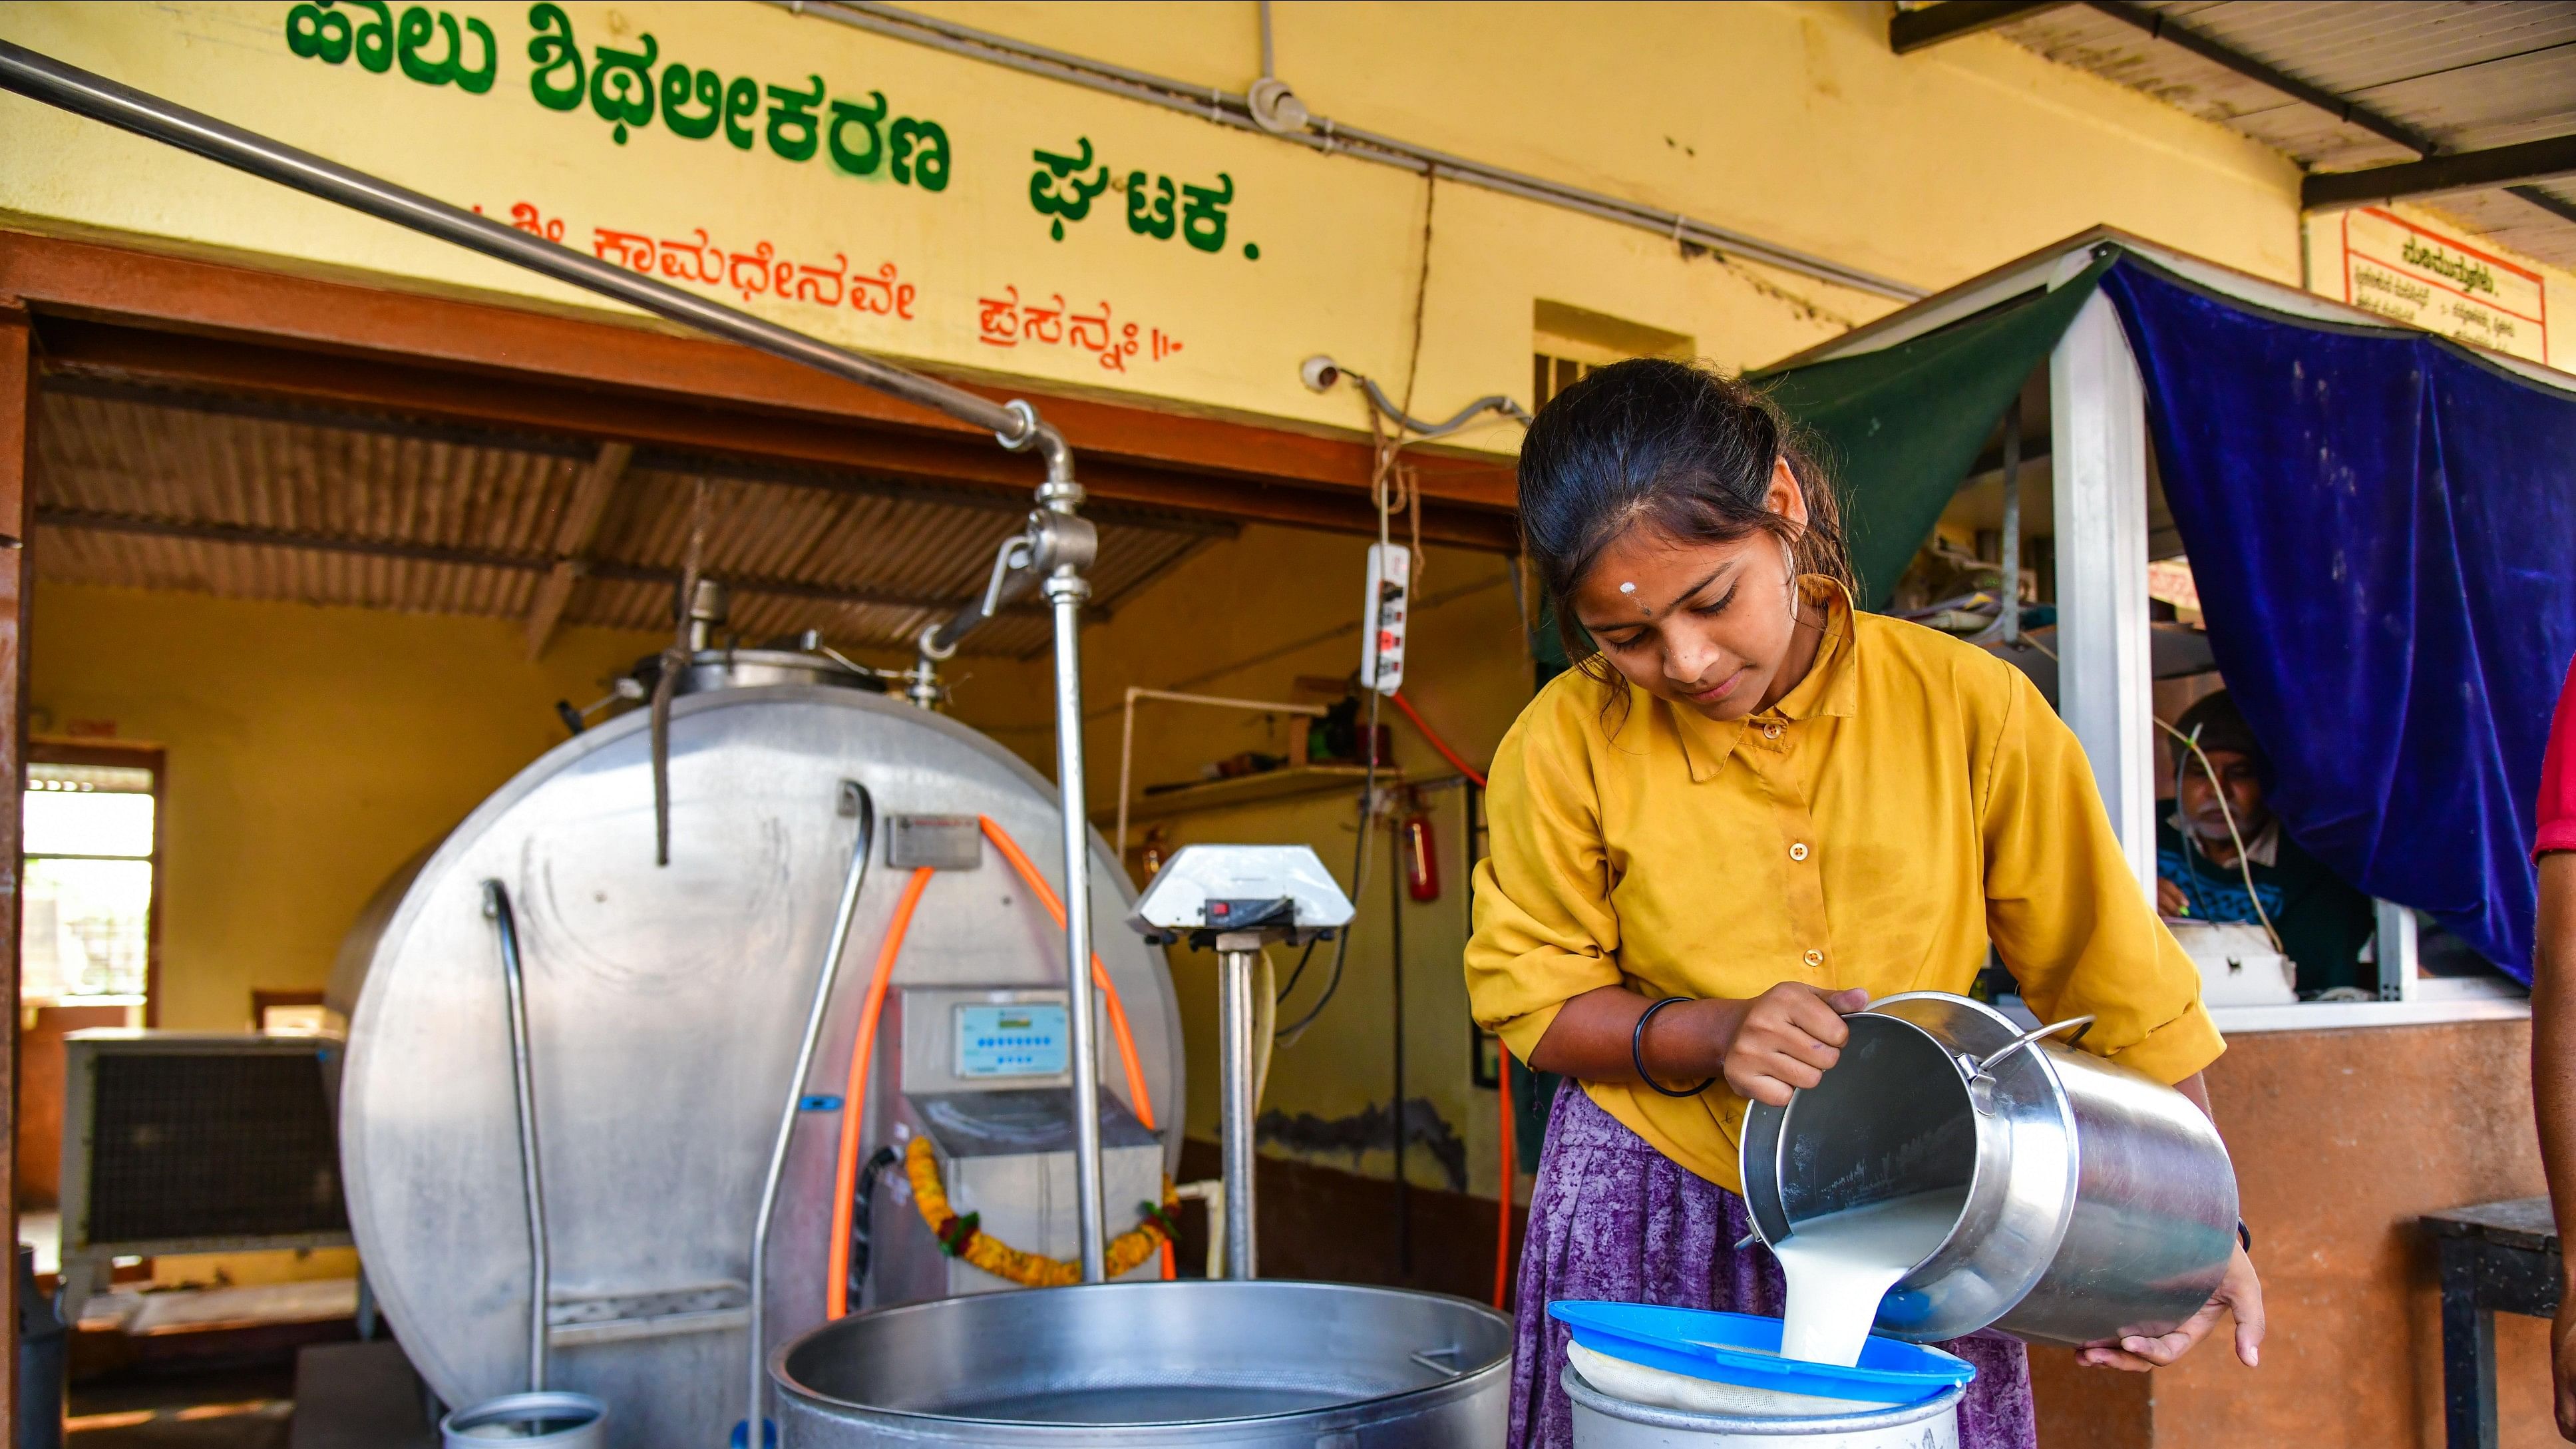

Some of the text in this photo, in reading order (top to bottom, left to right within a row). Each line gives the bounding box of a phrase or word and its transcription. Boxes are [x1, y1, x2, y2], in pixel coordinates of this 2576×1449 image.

[286, 1, 498, 95] ಹಾಲು
[527, 1, 950, 192] ಶಿಥಲೀಕರಣ
[592, 227, 916, 321] ಕಾಮಧೇನವೇ
